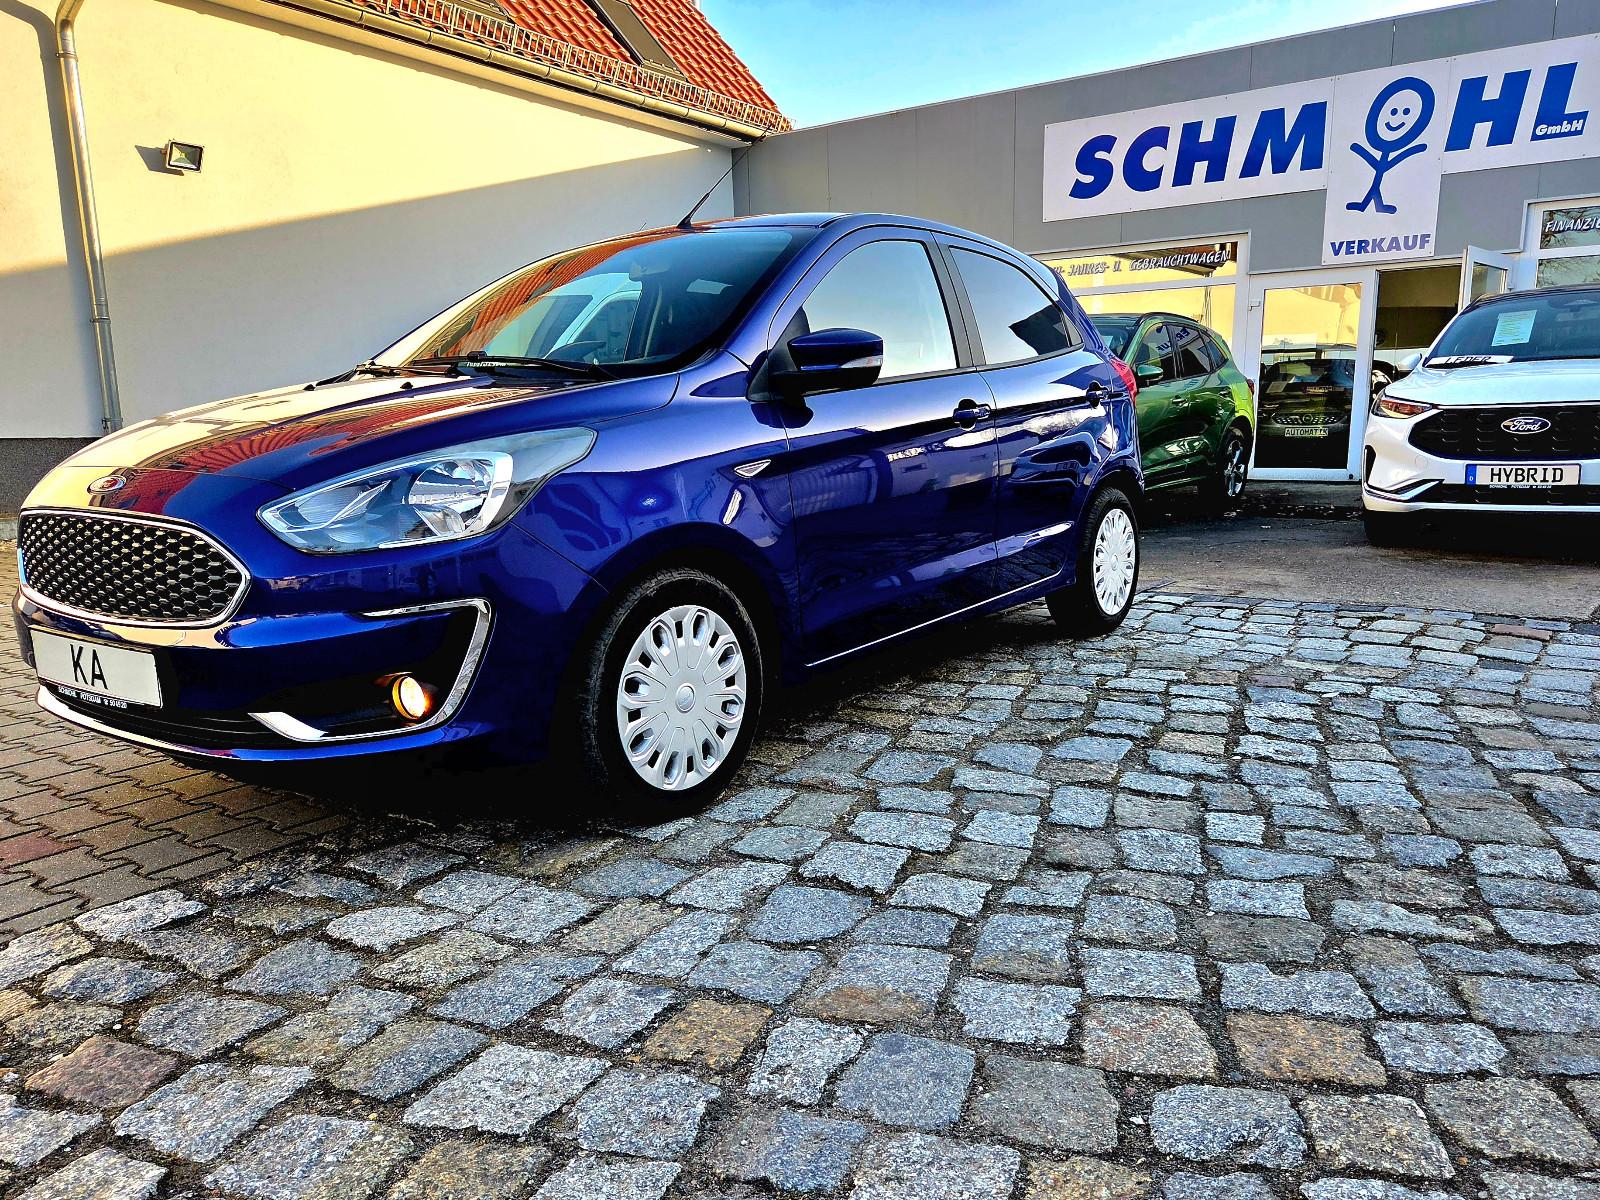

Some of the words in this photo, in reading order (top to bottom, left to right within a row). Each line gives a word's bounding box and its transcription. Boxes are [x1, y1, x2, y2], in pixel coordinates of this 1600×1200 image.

[1535, 119, 1583, 136] GmbH
[1330, 233, 1431, 256] VERKAUF
[1068, 261, 1109, 276] JAHRES-
[1129, 250, 1227, 271] GEBRAUCHTWAGEN
[1509, 419, 1542, 431] Ford
[1490, 467, 1563, 483] HYBRID
[70, 644, 108, 690] KA
